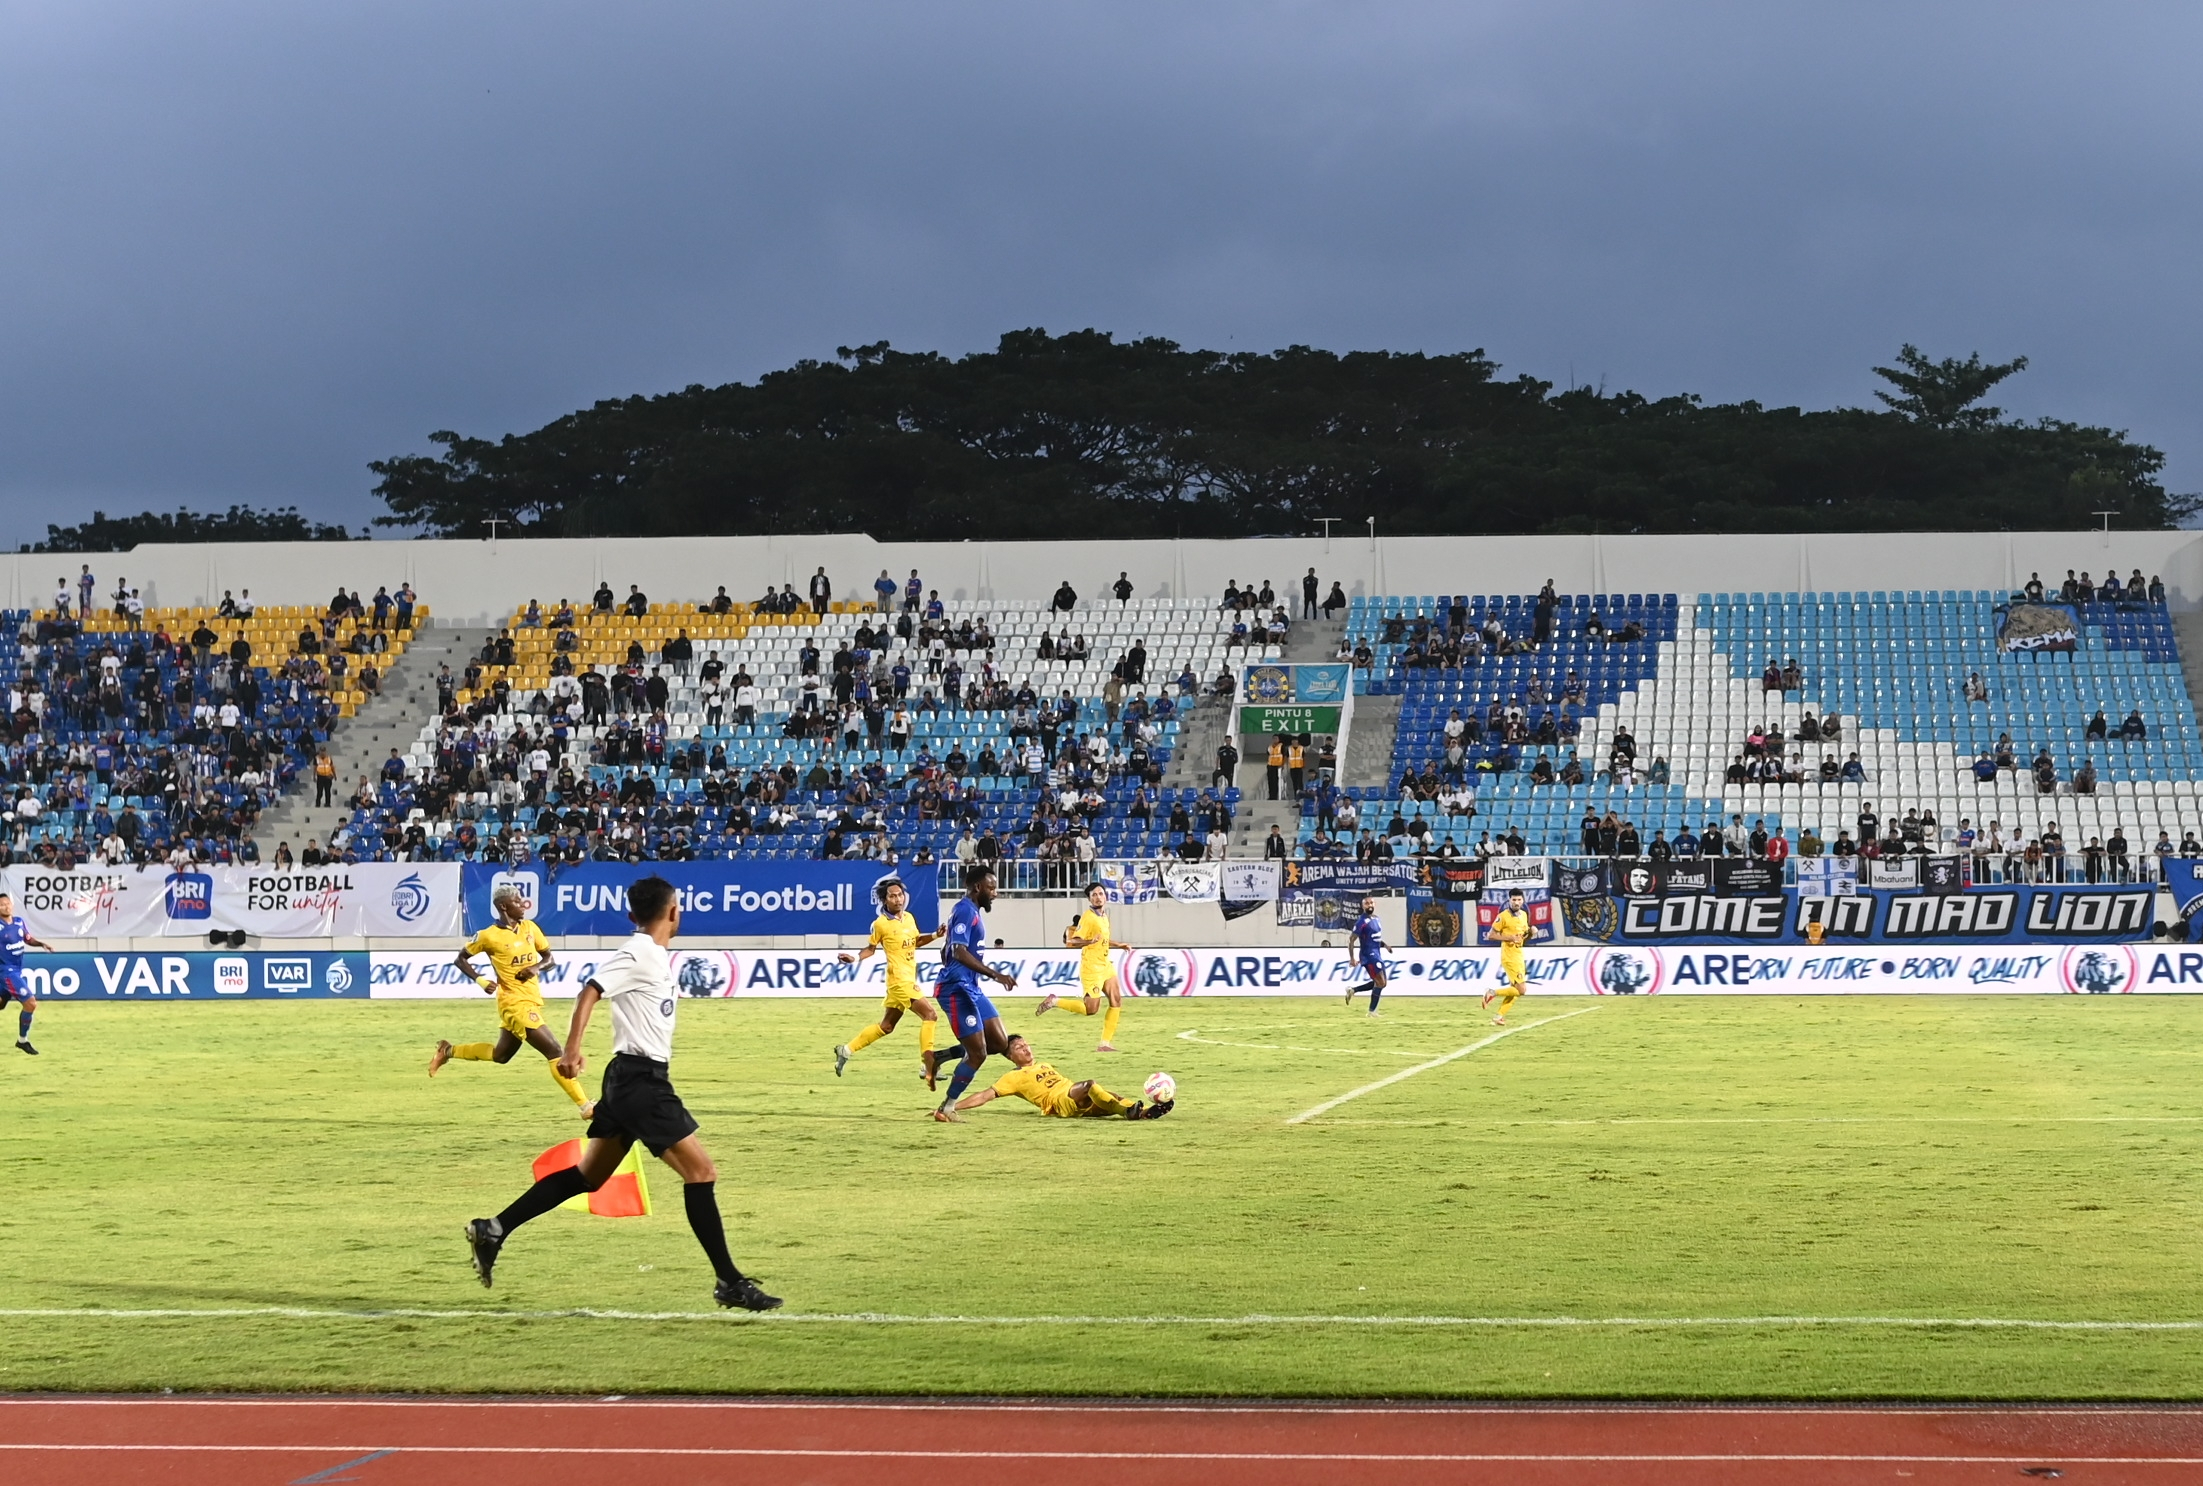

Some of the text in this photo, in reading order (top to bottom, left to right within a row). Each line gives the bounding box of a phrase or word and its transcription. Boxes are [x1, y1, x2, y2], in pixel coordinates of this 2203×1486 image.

[1265, 709, 1312, 718] PINTU 8
[1262, 719, 1315, 731] EXIT
[1301, 867, 1334, 884] AREMA
[1335, 865, 1370, 877] WAJAH
[1493, 863, 1543, 881] LITTLELION
[25, 874, 127, 892] FOOTBALL
[172, 880, 205, 899] BRI
[249, 874, 353, 892] FOOTBALL
[24, 895, 63, 910] FOR
[248, 882, 343, 924] FOR unity.
[557, 884, 714, 912] FUNttic
[723, 883, 853, 912] Football
[1480, 888, 1548, 904] ARMA
[1281, 901, 1314, 919] AREMA
[1624, 895, 1784, 933] COME
[1887, 894, 2014, 933] MAD
[94, 956, 191, 995] VAR
[220, 966, 242, 976] BRI
[270, 965, 305, 980] VAR
[370, 962, 411, 985] ORN
[746, 958, 820, 989] ARE
[820, 961, 861, 984] ORN
[980, 960, 1026, 982] ORN
[1032, 960, 1081, 988] QUAL
[1205, 956, 1281, 987] ARE
[1281, 958, 1323, 982] ORN
[1428, 958, 1489, 981] BORN
[1672, 954, 1750, 986] ARE
[1750, 956, 1793, 981] ORN
[1798, 956, 1878, 981] FUTURE
[1900, 956, 1962, 980] BORN
[223, 977, 245, 986] mo
